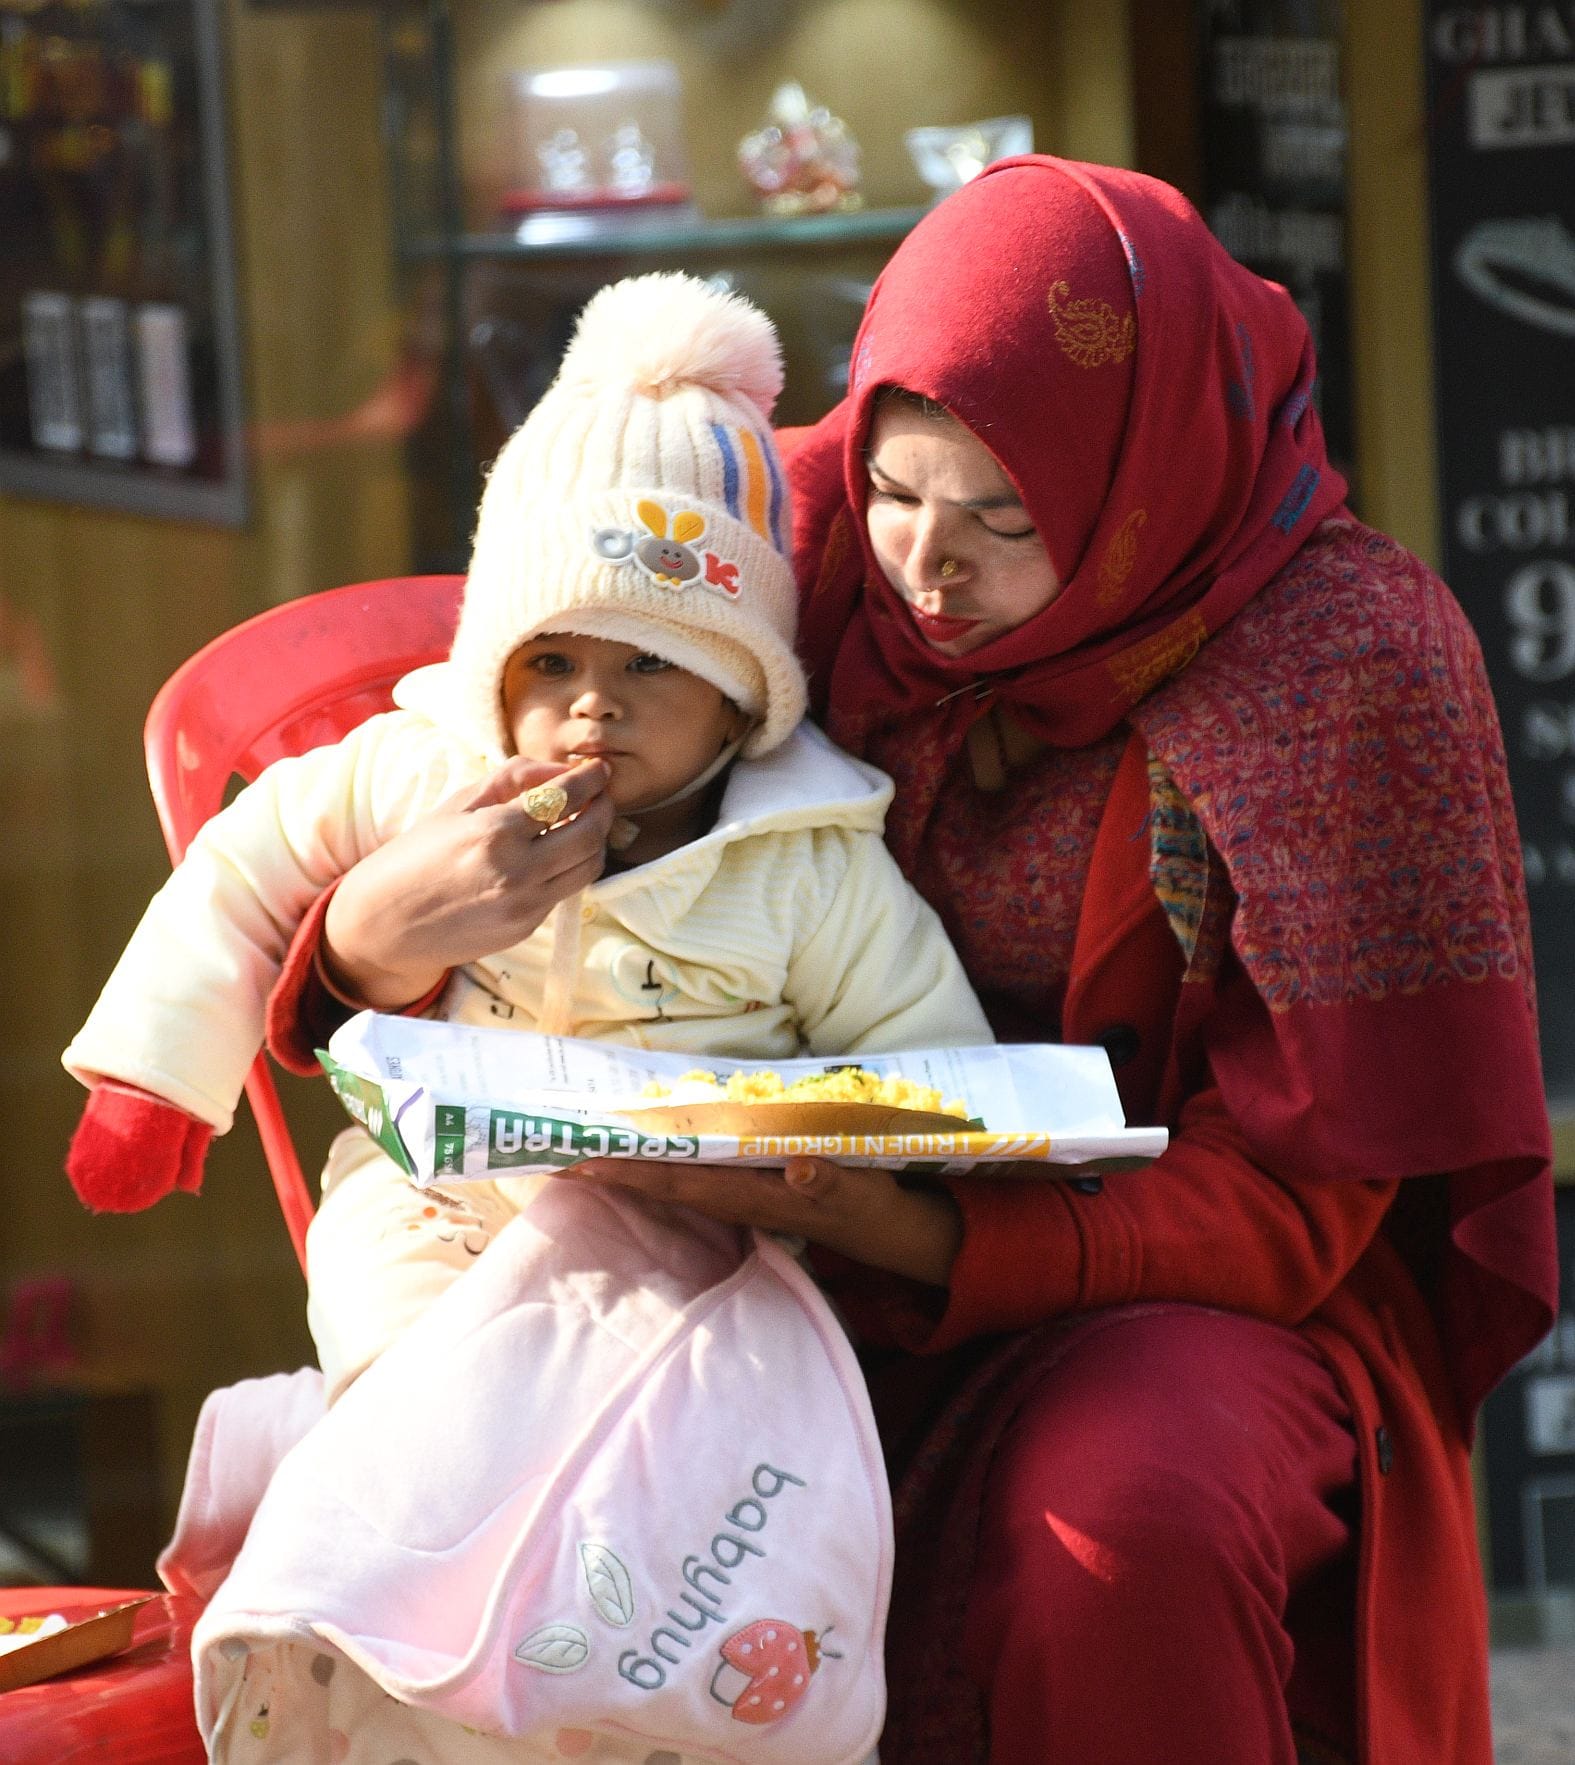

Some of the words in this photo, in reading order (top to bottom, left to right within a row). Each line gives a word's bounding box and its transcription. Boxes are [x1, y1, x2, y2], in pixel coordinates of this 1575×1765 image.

[1431, 5, 1575, 61] GHA
[495, 1117, 697, 1158] SPECTRA
[617, 1462, 807, 1690] babyhug
